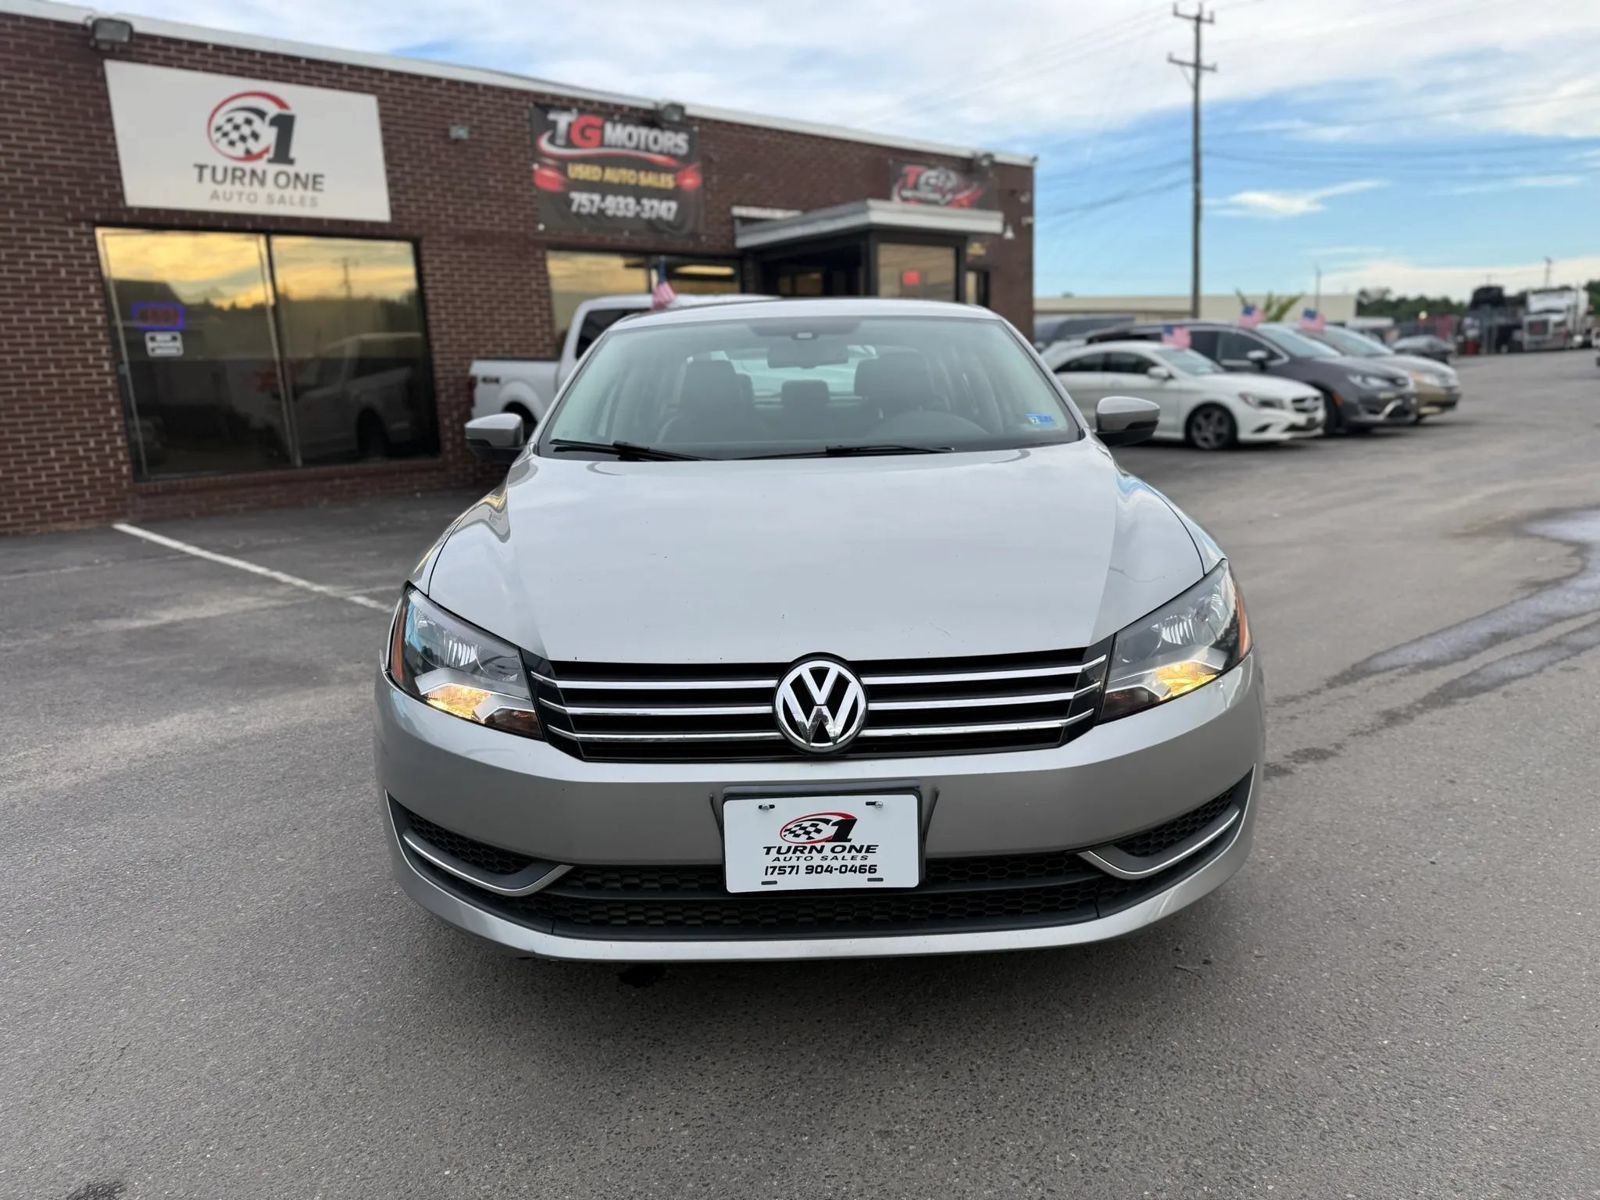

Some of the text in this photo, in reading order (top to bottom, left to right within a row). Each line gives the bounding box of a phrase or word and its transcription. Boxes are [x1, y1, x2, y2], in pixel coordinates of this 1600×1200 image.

[547, 110, 689, 156] TG MOTORS
[193, 163, 325, 193] TURN ONE
[567, 163, 676, 190] USED AUTO SALES
[209, 189, 319, 208] AUTO SALES
[762, 844, 879, 855] TURN ONE
[804, 864, 877, 875] 904-0466
